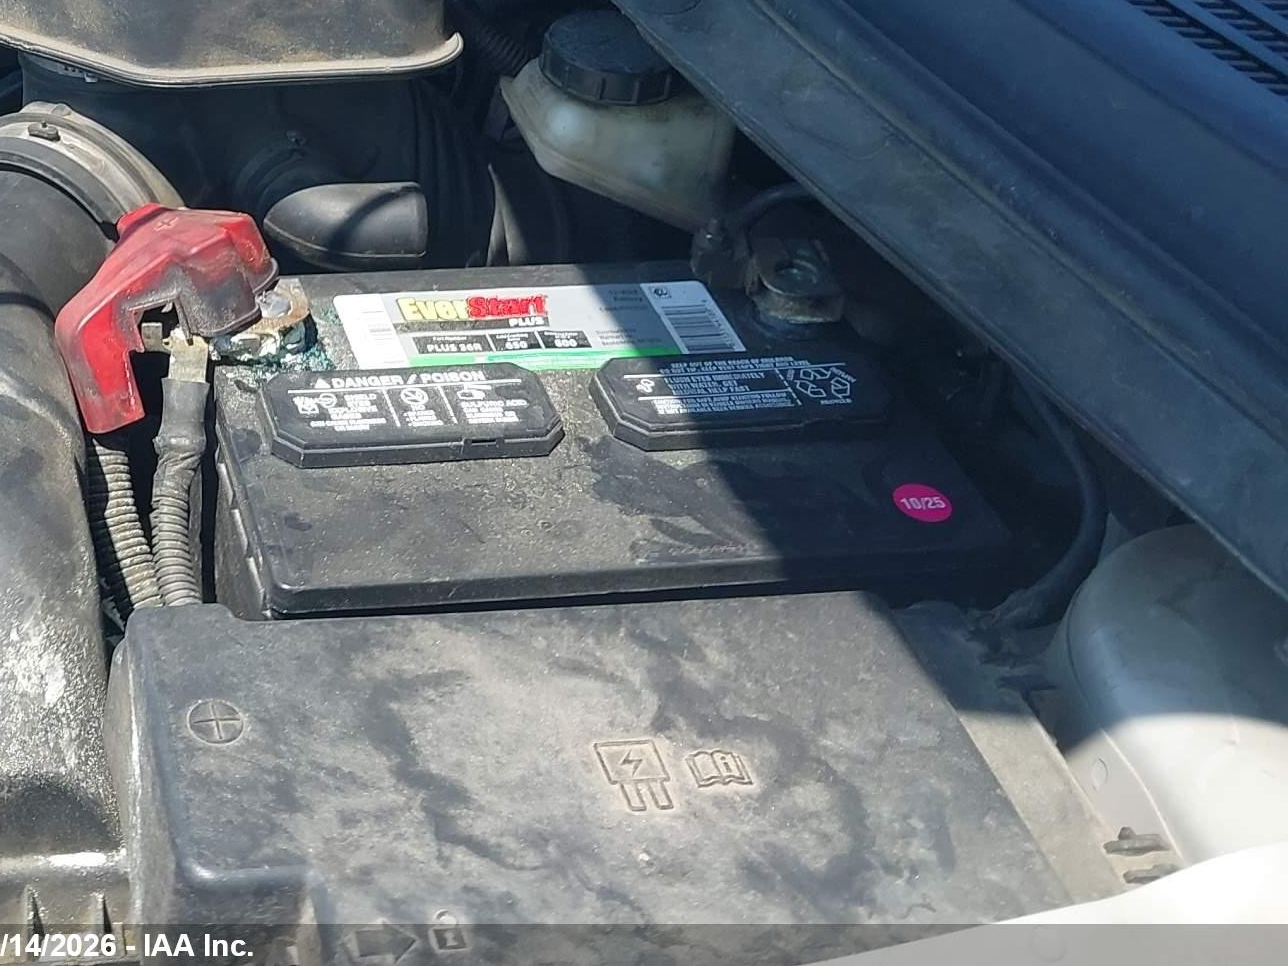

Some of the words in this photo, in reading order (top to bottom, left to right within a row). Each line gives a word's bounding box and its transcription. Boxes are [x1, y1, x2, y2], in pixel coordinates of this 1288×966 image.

[396, 294, 548, 322] EverStart
[508, 315, 545, 327] PLUS
[427, 343, 457, 353] PLUS
[331, 375, 404, 389] DANGER
[407, 373, 417, 385] /
[420, 370, 486, 384] POISON
[900, 496, 946, 511] 10/25
